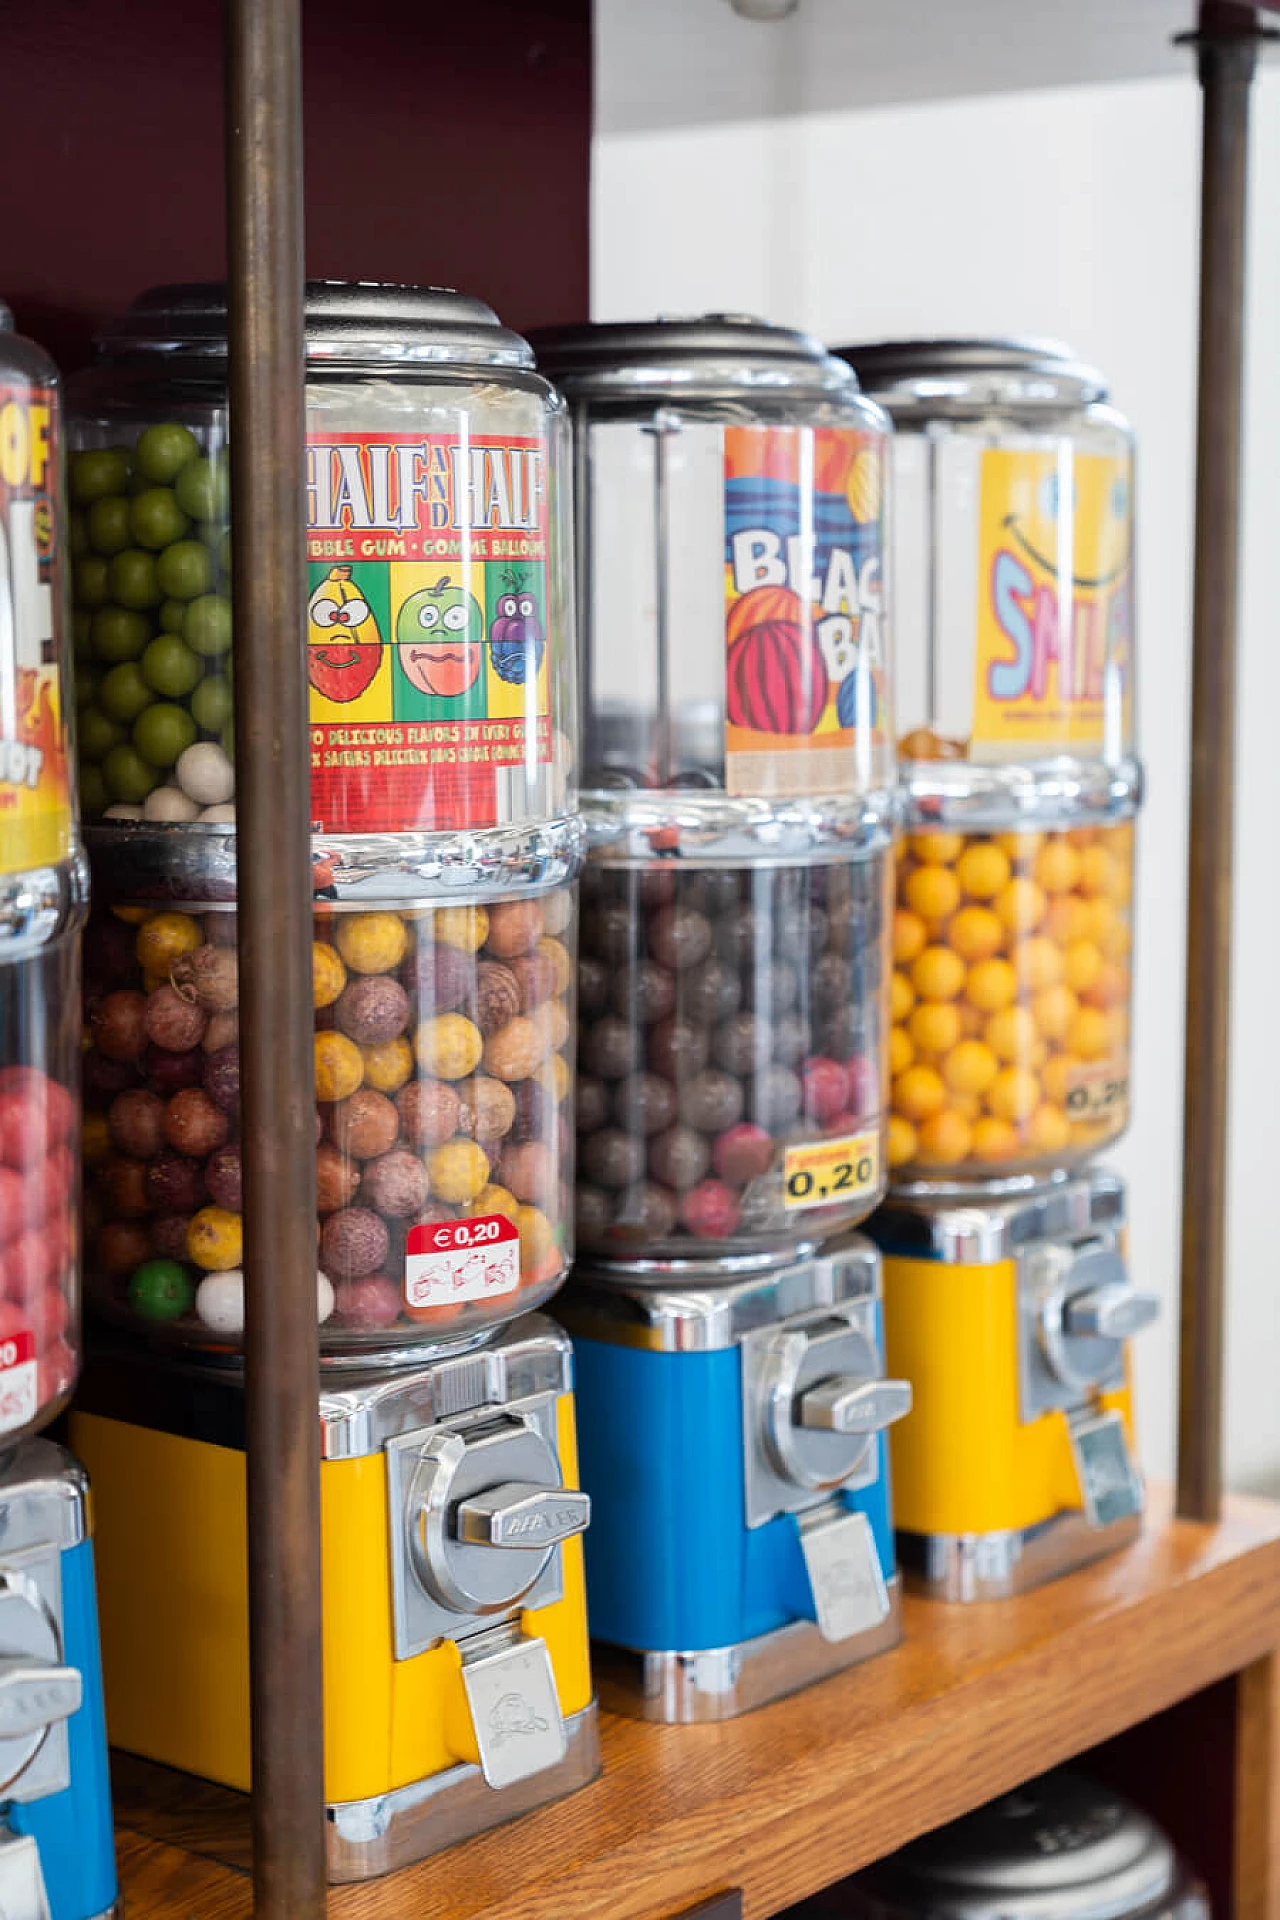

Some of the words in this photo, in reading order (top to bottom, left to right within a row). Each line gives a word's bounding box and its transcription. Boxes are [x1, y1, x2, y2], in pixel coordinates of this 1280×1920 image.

[307, 538, 354, 557] BBLE
[361, 538, 406, 557] GUM
[328, 728, 404, 746] DELICIOUS
[407, 726, 459, 744] FLAVORS
